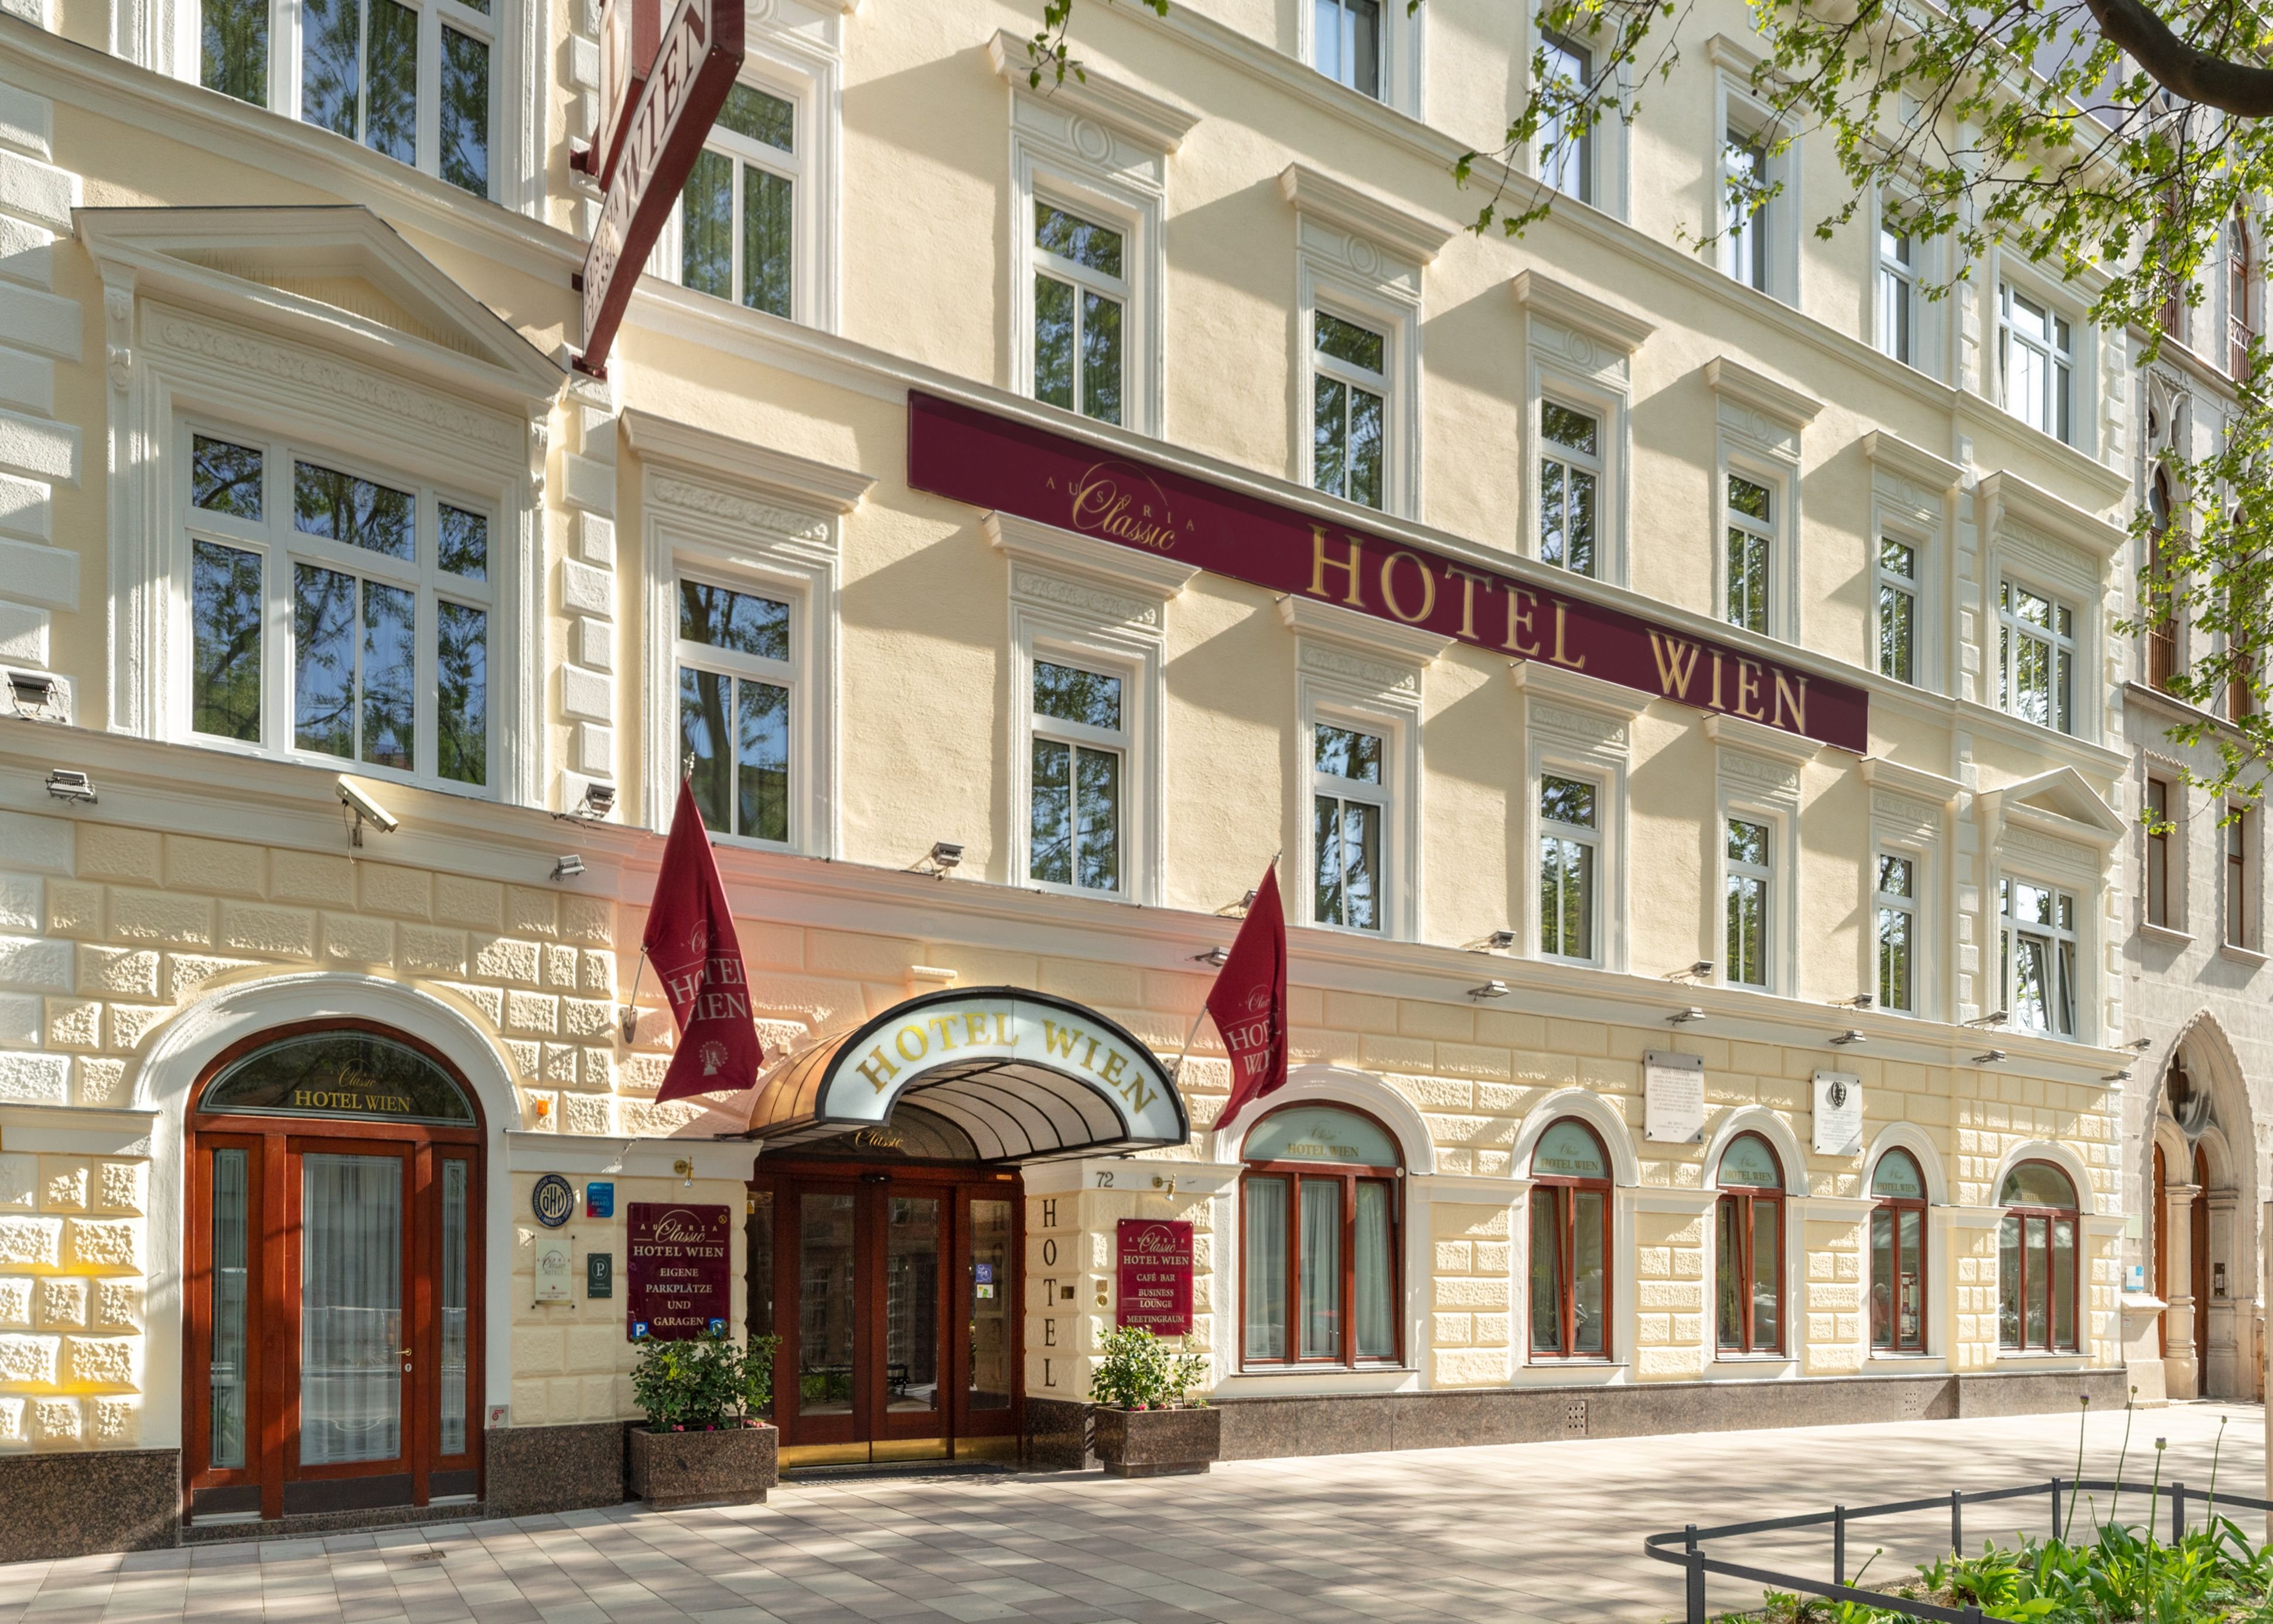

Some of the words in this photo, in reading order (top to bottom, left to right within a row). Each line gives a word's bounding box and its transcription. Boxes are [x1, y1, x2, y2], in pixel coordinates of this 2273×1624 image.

[621, 0, 706, 220] WIEN
[1045, 476, 1195, 531] AUSTRIA
[1071, 478, 1175, 551] Classic
[1306, 523, 1586, 670] HOTEL
[1644, 627, 1810, 735] WIEN
[855, 1012, 1019, 1095] HOTEL
[1041, 1018, 1159, 1114] WIEN
[339, 1066, 377, 1088] Classic
[295, 1090, 362, 1110] HOTEL
[365, 1094, 410, 1113] WIEN
[1288, 1143, 1326, 1156] HOTEL
[1329, 1145, 1359, 1157] WIEN
[1541, 1158, 1573, 1169] HOTEL
[1574, 1160, 1599, 1171] WIEN
[1096, 1171, 1114, 1188] 72
[1725, 1170, 1752, 1180] HOTEL
[1753, 1172, 1773, 1182] WIEN
[1877, 1182, 1899, 1192] HOTEL
[1900, 1183, 1917, 1192] WIEN
[2022, 1192, 2040, 1201] HOTEL
[641, 1223, 718, 1232] AUSTRIA
[655, 1219, 706, 1243] Classic
[1139, 1233, 1176, 1254] Classic
[633, 1246, 682, 1257] HOTEL
[685, 1247, 724, 1257] WIEN
[1123, 1255, 1159, 1265] HOTEL
[1162, 1256, 1189, 1265] WIEN
[660, 1268, 699, 1277] EIGENE
[1136, 1272, 1156, 1282] CAFÉ
[646, 1283, 712, 1294] PARKPLÄTZE
[1043, 1199, 1057, 1387] HOTEL
[1138, 1288, 1174, 1297] BUSINESS
[667, 1301, 691, 1309] UND
[1140, 1300, 1172, 1308] LOUNGE
[653, 1317, 704, 1326] GARAGEN
[1127, 1315, 1185, 1323] MEETINGRAUM
